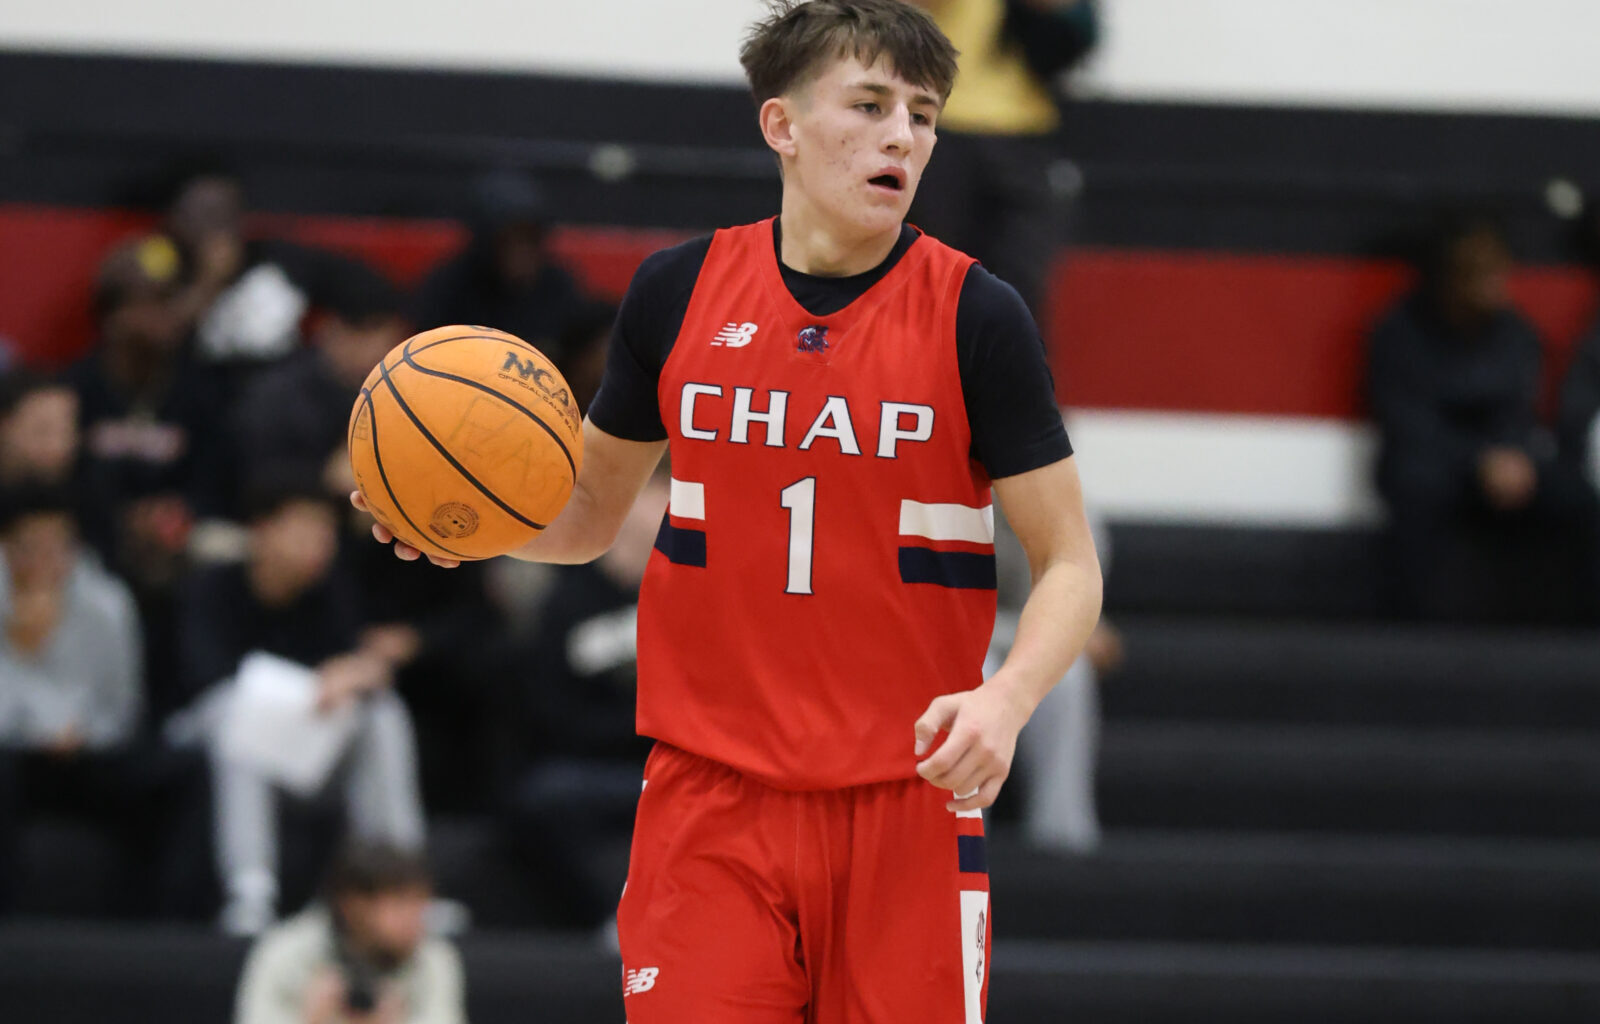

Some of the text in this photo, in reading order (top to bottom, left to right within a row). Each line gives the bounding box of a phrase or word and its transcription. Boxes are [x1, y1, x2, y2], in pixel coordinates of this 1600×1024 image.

[498, 373, 541, 397] OFFICIAL
[680, 382, 935, 459] CHAP
[780, 477, 816, 595] 1
